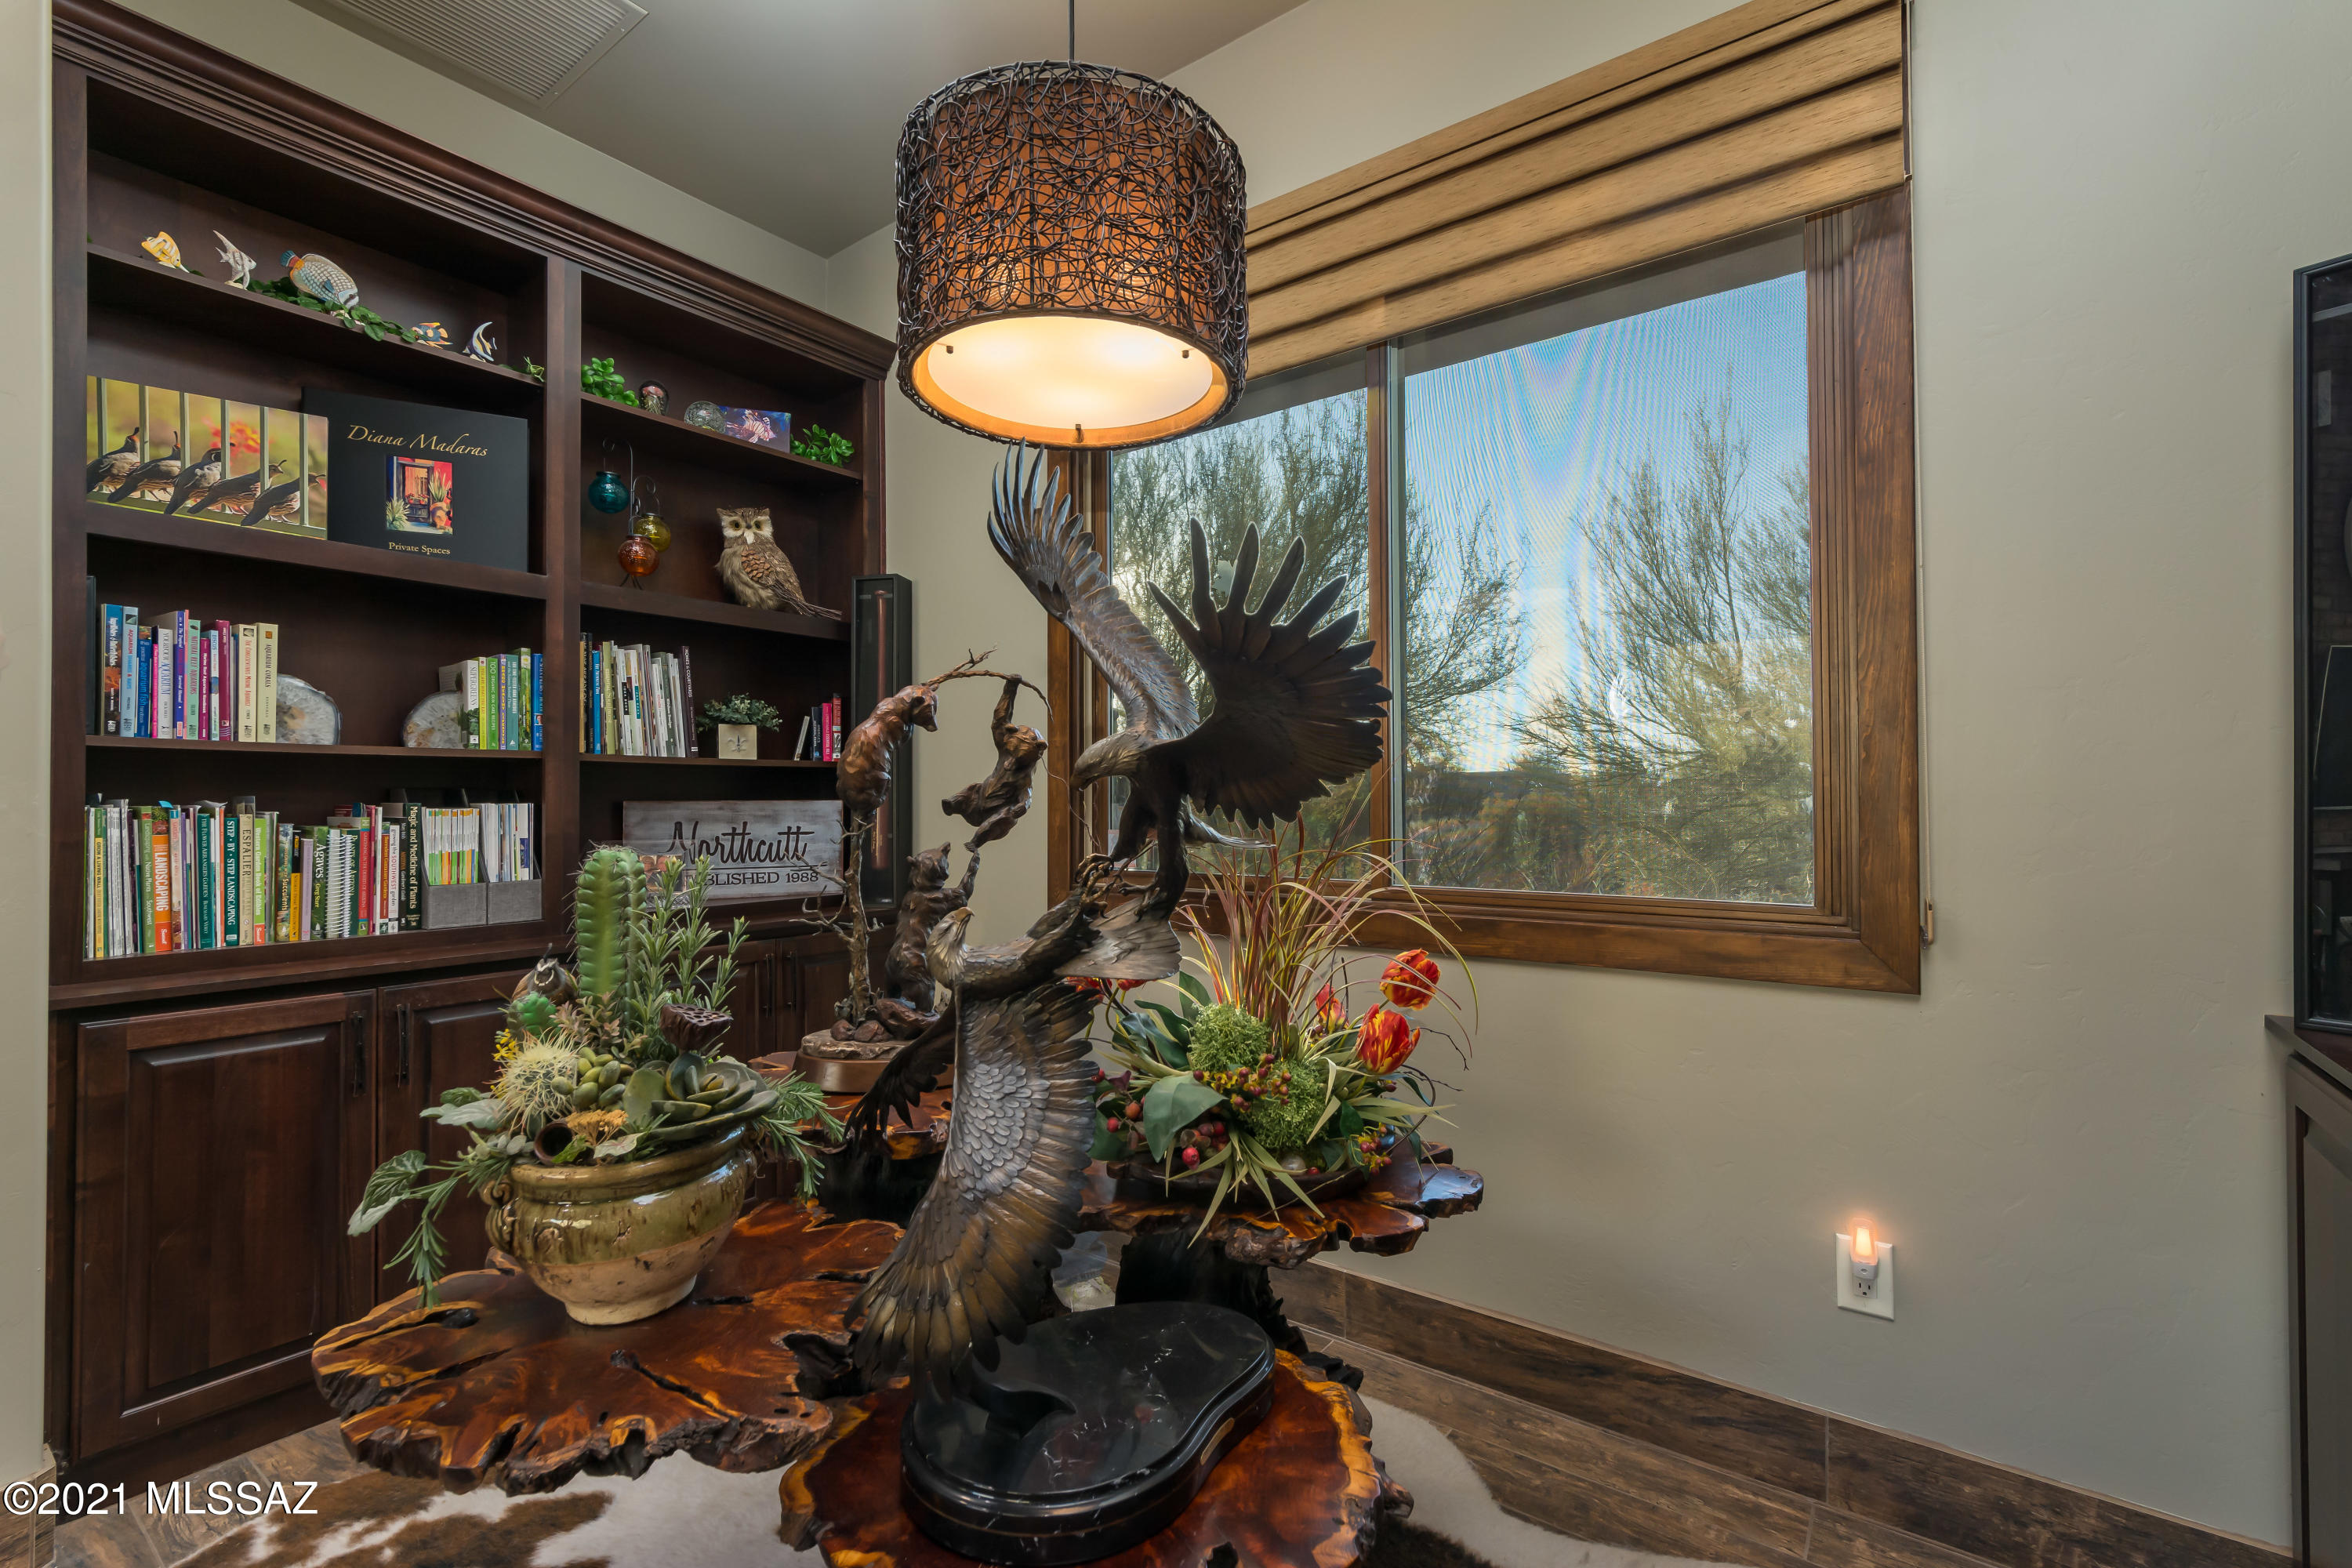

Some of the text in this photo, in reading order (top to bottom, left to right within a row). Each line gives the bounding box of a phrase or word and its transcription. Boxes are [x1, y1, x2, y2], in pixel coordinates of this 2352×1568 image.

[347, 425, 488, 456] Diana Madaras
[389, 542, 451, 555] Private Spaces
[159, 662, 171, 695] AQUARIUM
[140, 694, 149, 706] fish
[408, 806, 418, 827] Magic
[242, 829, 252, 876] ESPALIER
[666, 821, 815, 864] Northcutt
[227, 821, 236, 925] STEP BY STEP LANDSCAPING
[314, 844, 327, 878] Agaves
[409, 844, 418, 876] Medicine
[154, 852, 169, 911] LANDSCAPING
[687, 872, 818, 885] BLISHED 1988
[409, 886, 418, 909] Plants
